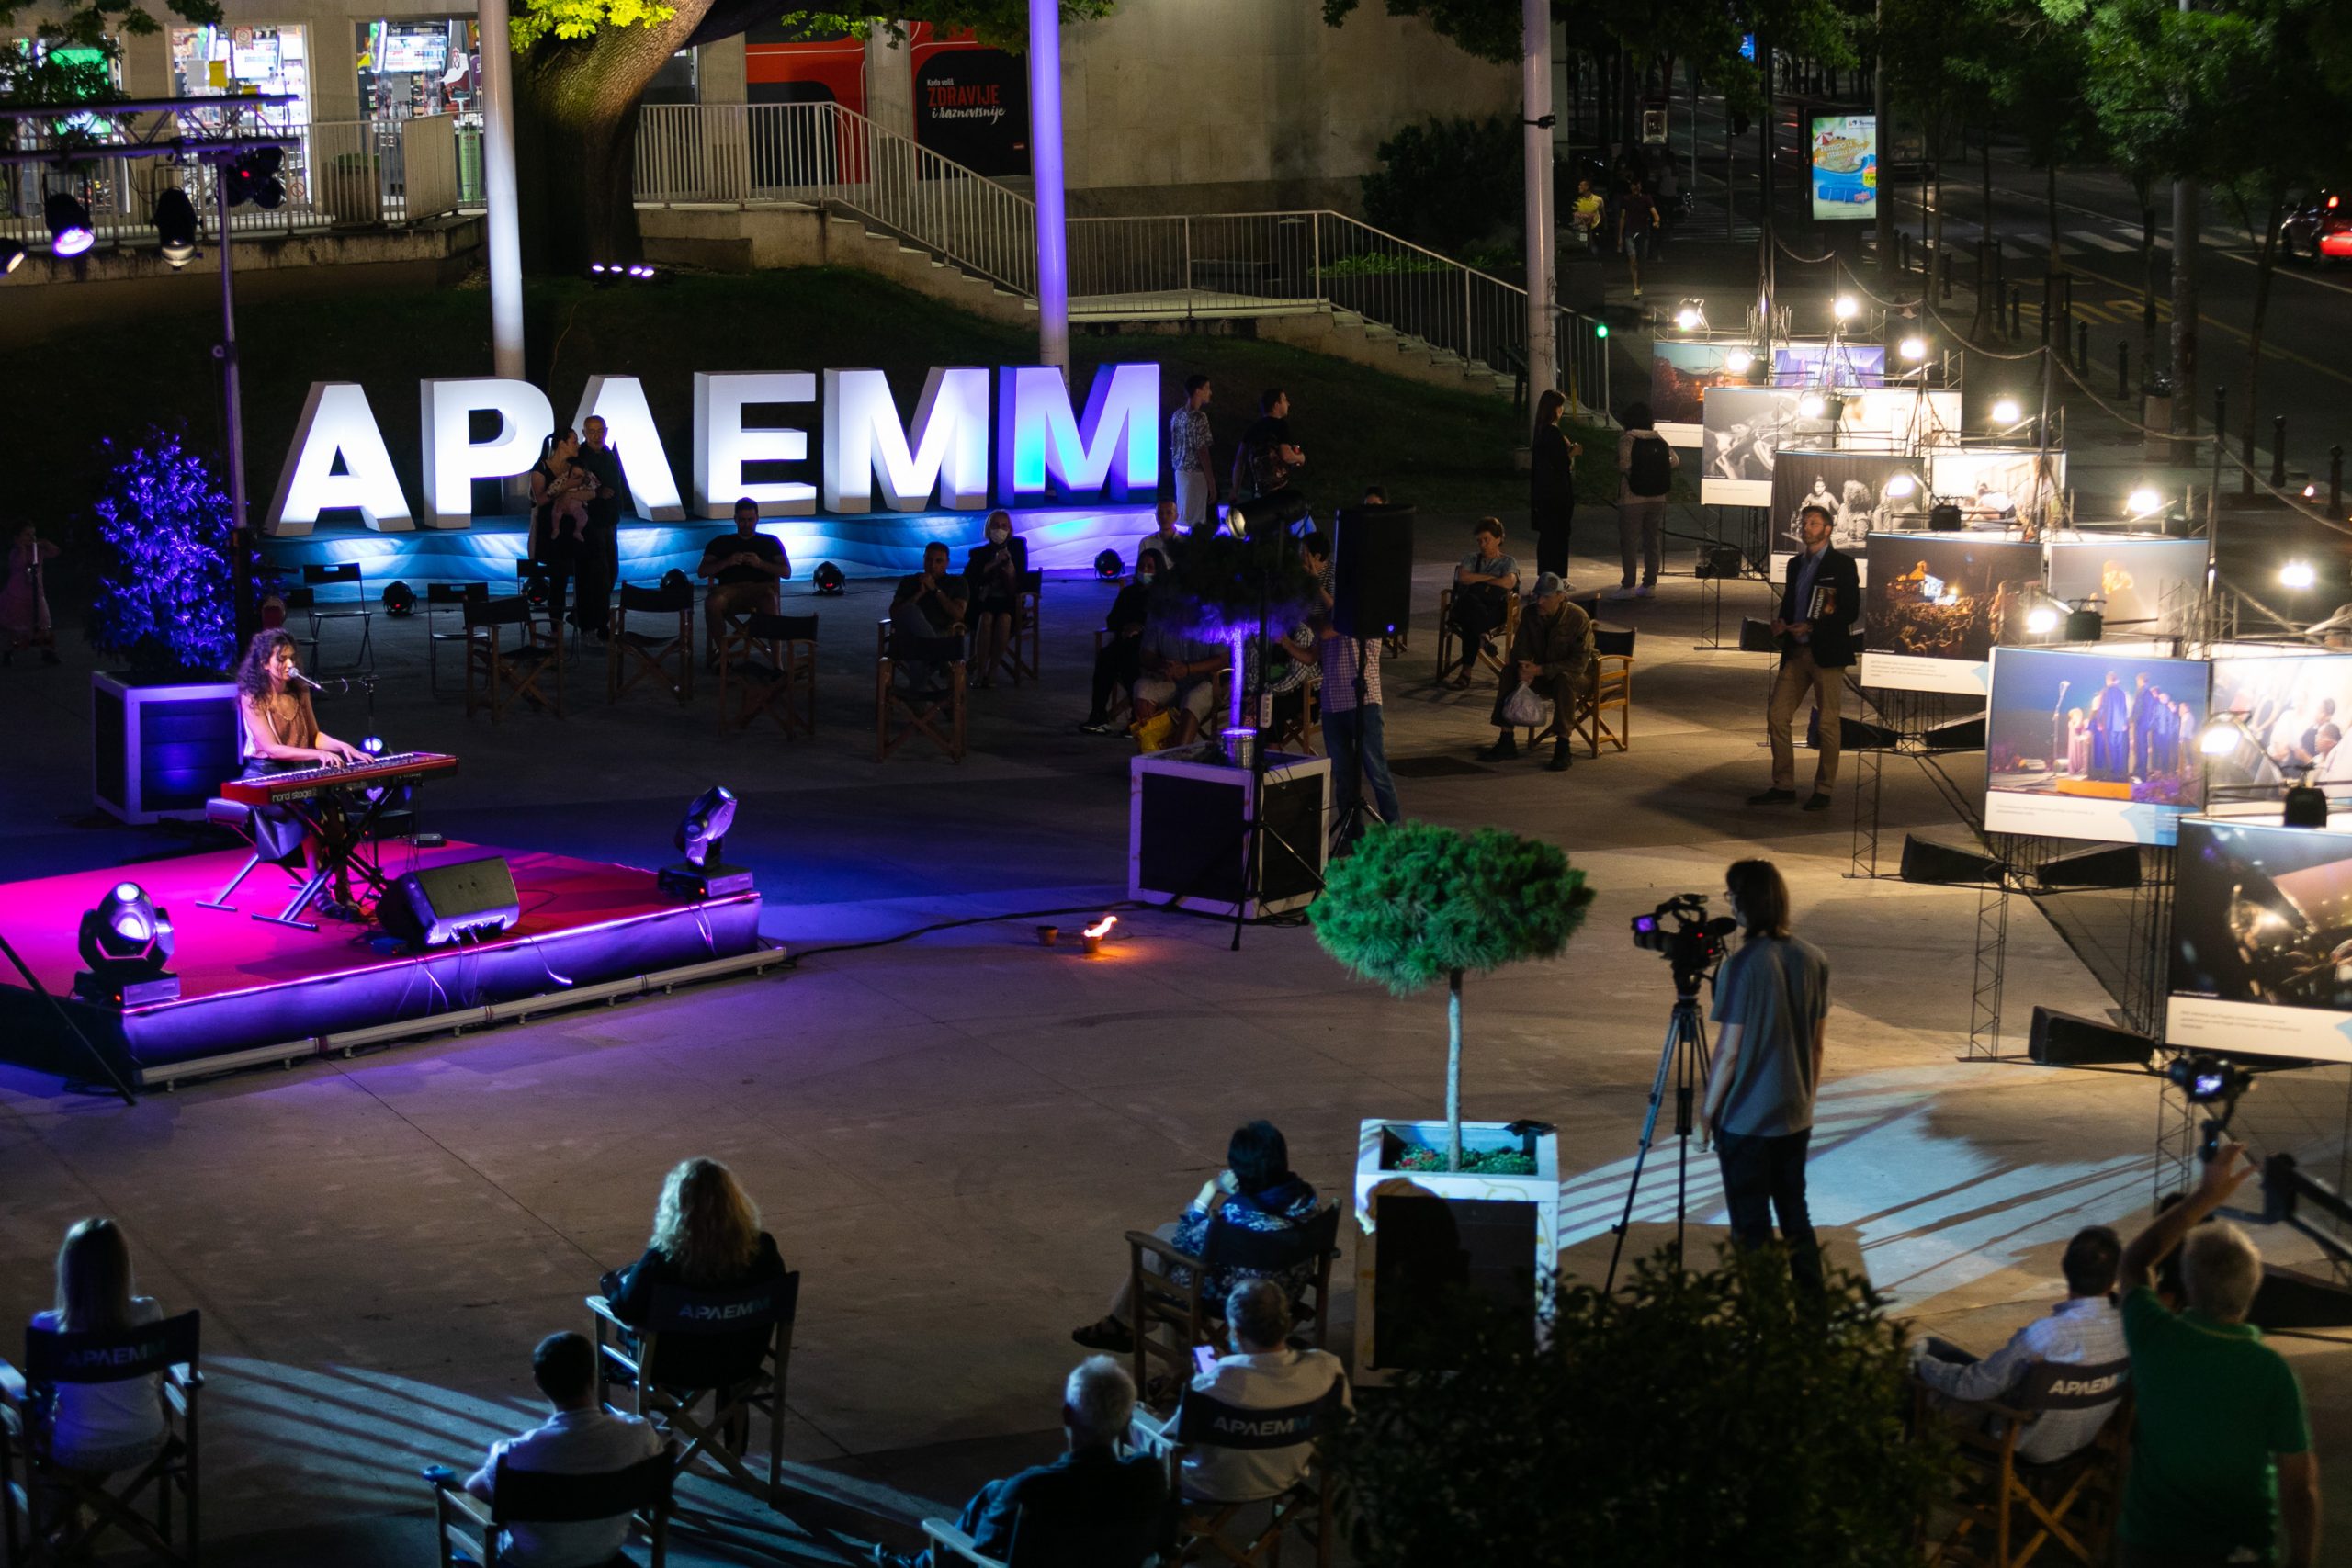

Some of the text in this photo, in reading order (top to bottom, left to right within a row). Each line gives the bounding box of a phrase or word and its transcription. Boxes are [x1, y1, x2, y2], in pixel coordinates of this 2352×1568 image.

[927, 85, 1001, 107] ZDRAVIJE
[939, 105, 1006, 126] raznovrsnije
[272, 791, 290, 803] nord
[291, 790, 312, 800] stage
